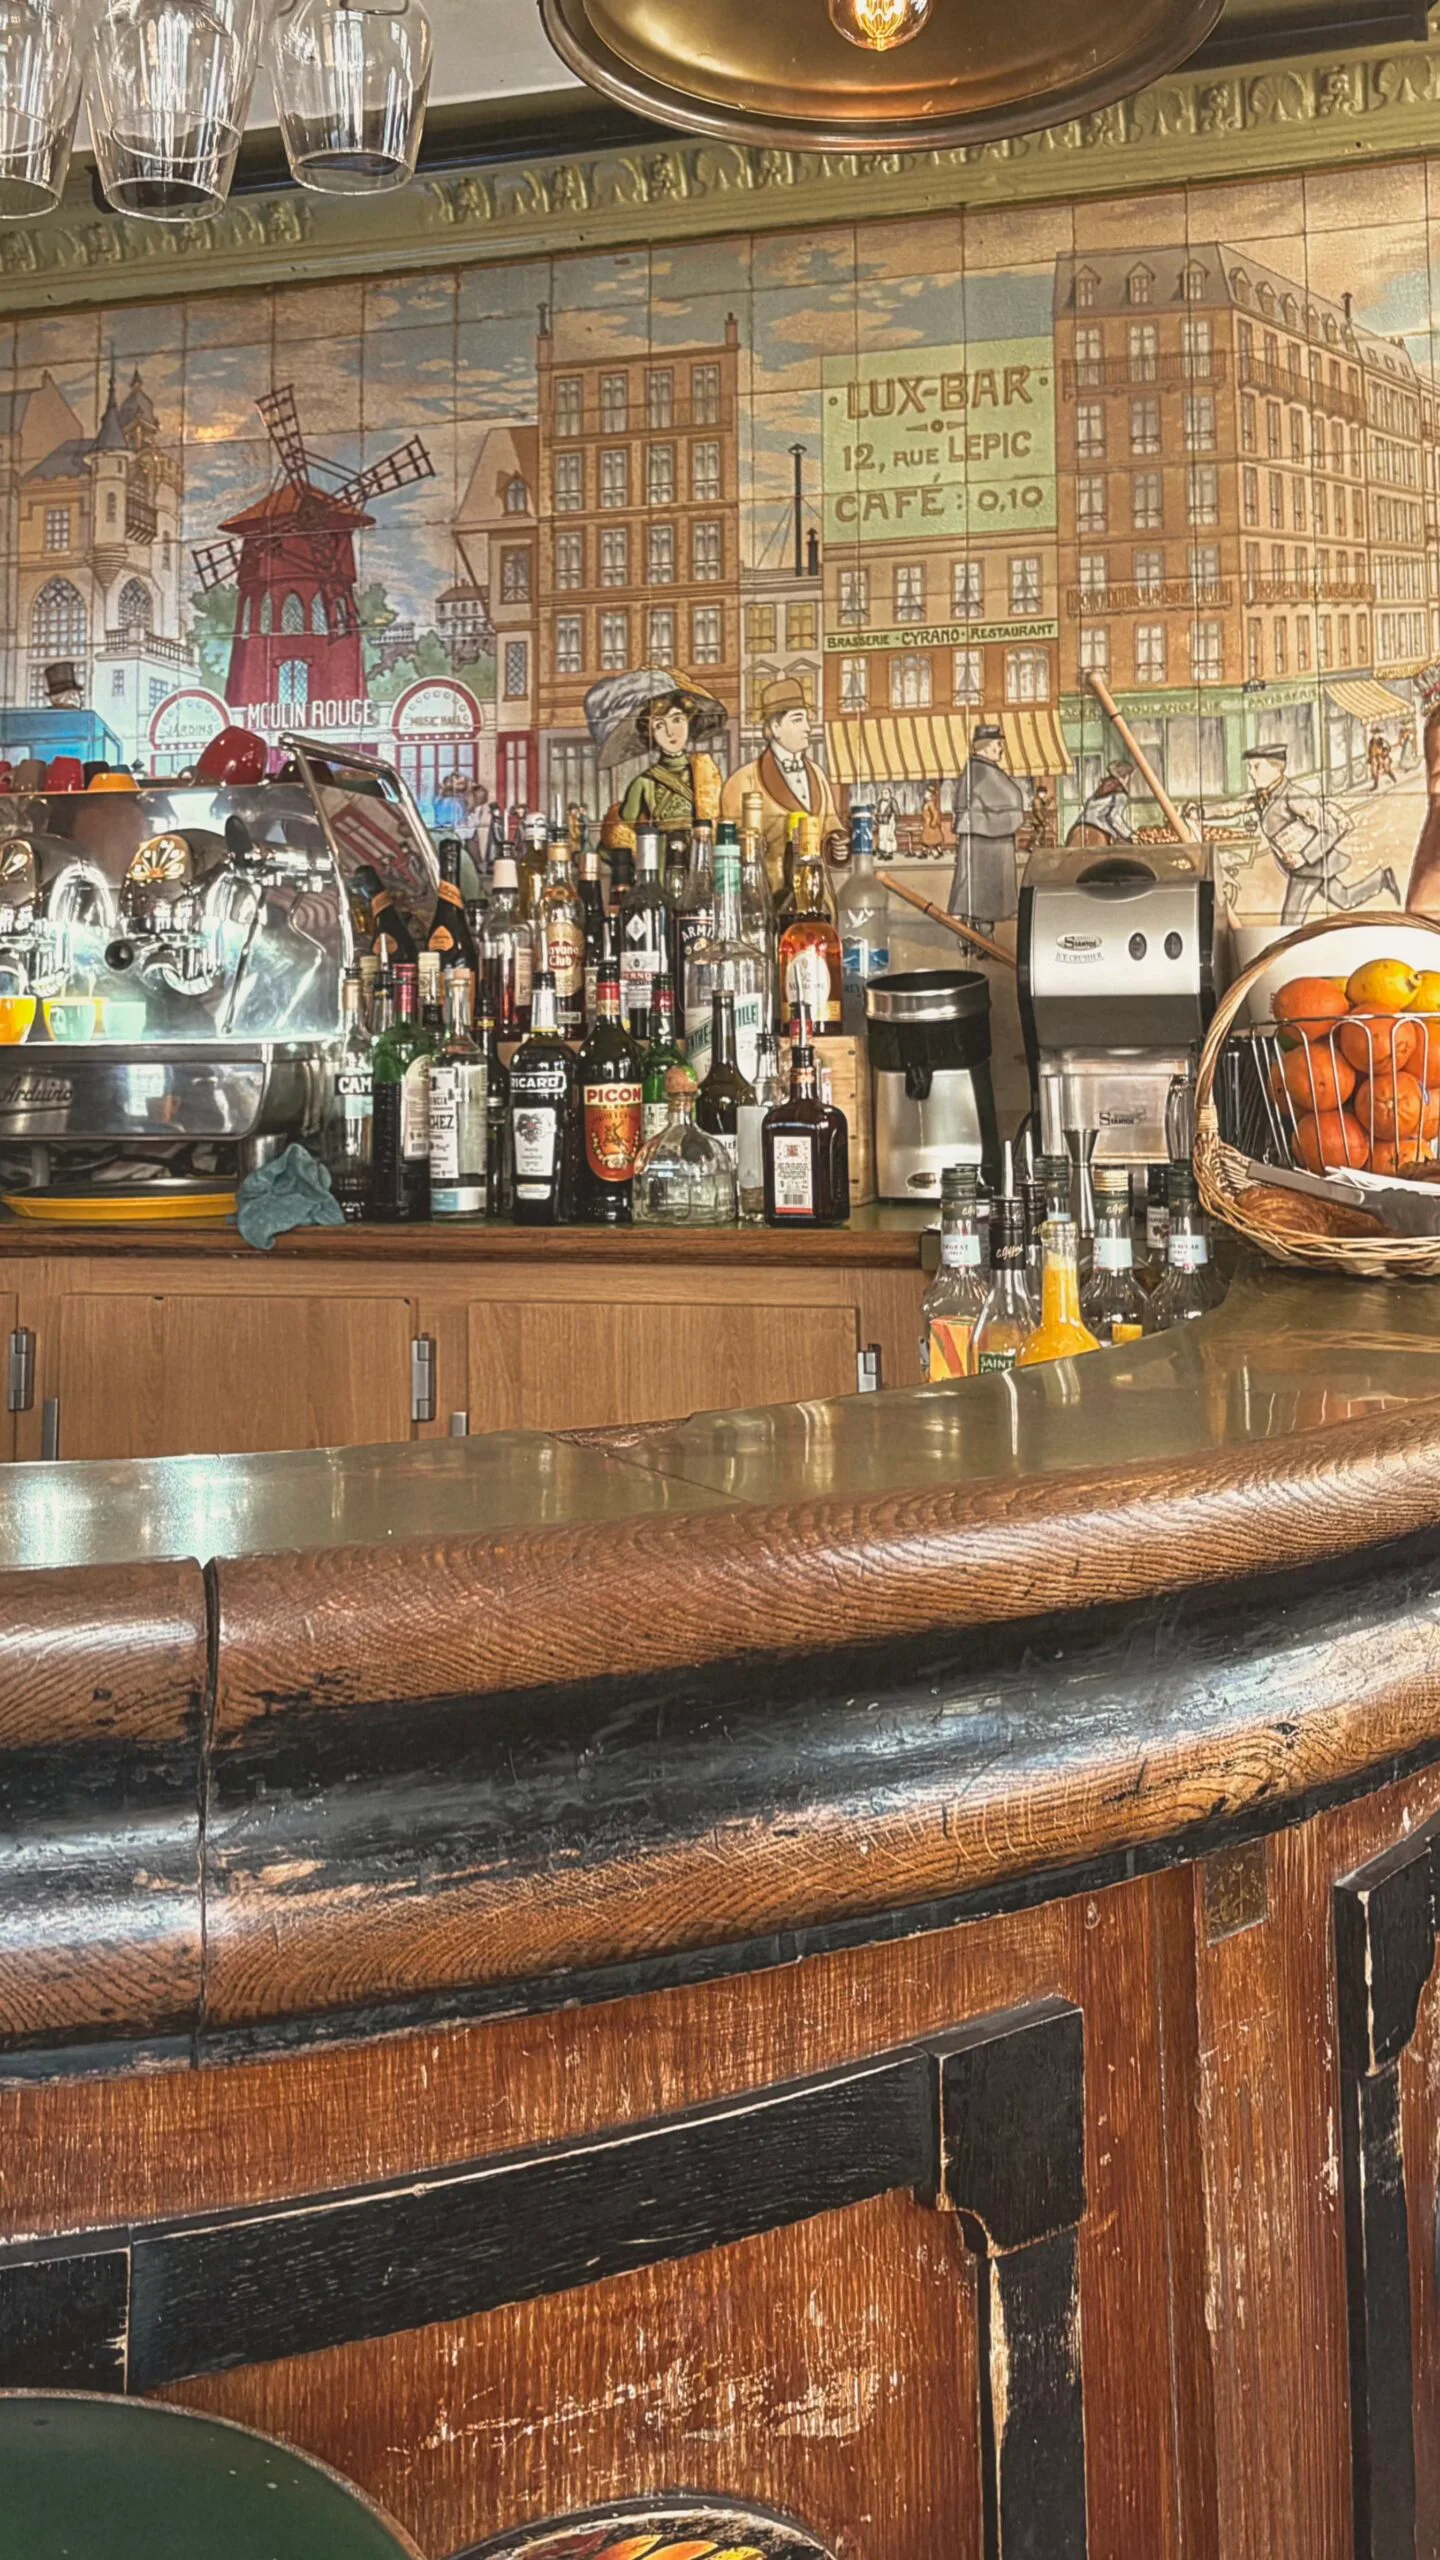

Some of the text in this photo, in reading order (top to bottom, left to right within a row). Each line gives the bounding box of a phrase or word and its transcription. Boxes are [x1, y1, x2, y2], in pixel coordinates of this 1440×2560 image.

[846, 365, 1034, 421] LUX-BAR
[842, 431, 1032, 474] 12, RUE LEPIC
[834, 473, 945, 523] CAFÉ
[827, 624, 1055, 650] BRASSERIE CYRANO RESTAURANT
[247, 699, 374, 730] MOULIN ROUGE
[166, 723, 213, 737] JARDINS
[511, 1077, 560, 1089] RICARD
[586, 1088, 641, 1103] PICON
[980, 1355, 1014, 1370] SAINT
